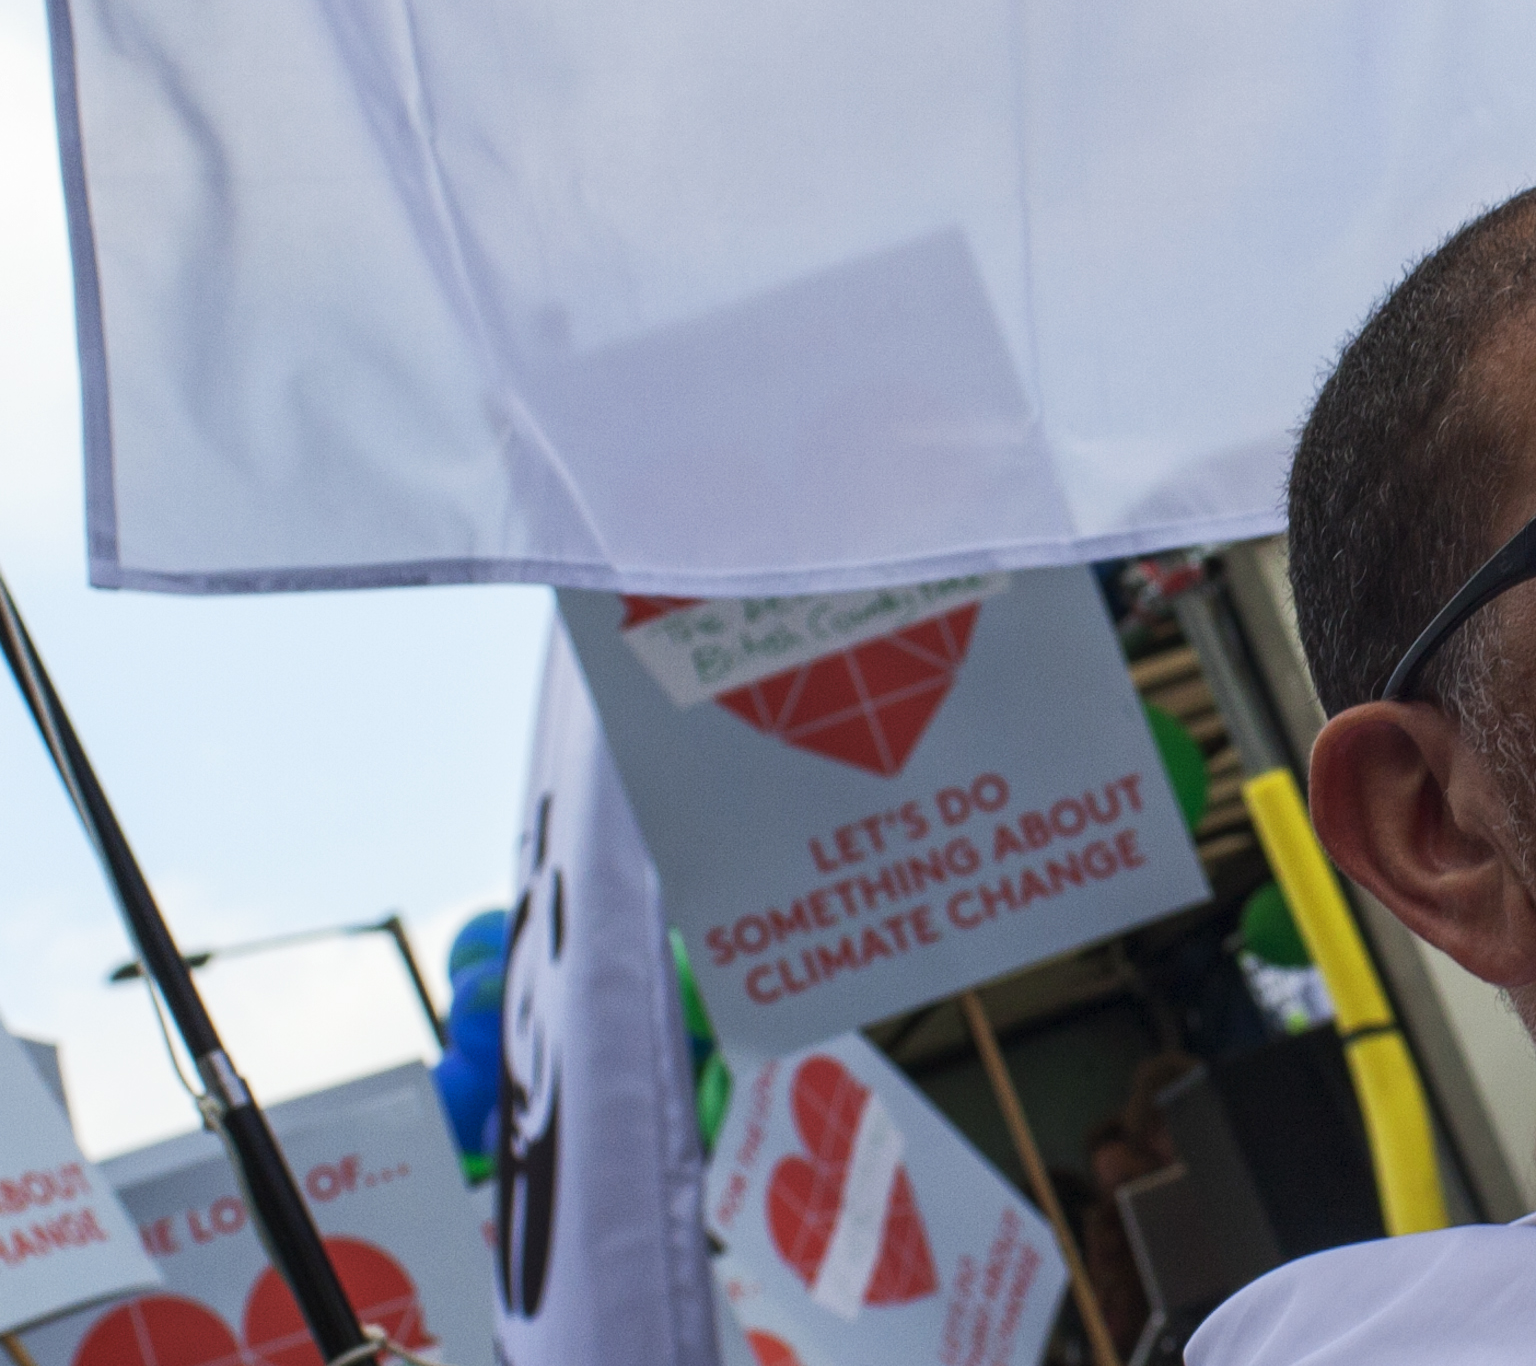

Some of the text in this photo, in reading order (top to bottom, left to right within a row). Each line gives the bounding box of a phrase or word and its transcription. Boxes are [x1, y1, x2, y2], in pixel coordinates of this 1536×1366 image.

[703, 771, 1148, 969] SOMETHING ABOUT
[806, 769, 1012, 875] LET'S DO
[743, 828, 1147, 1006] CLIMATE CHANGE
